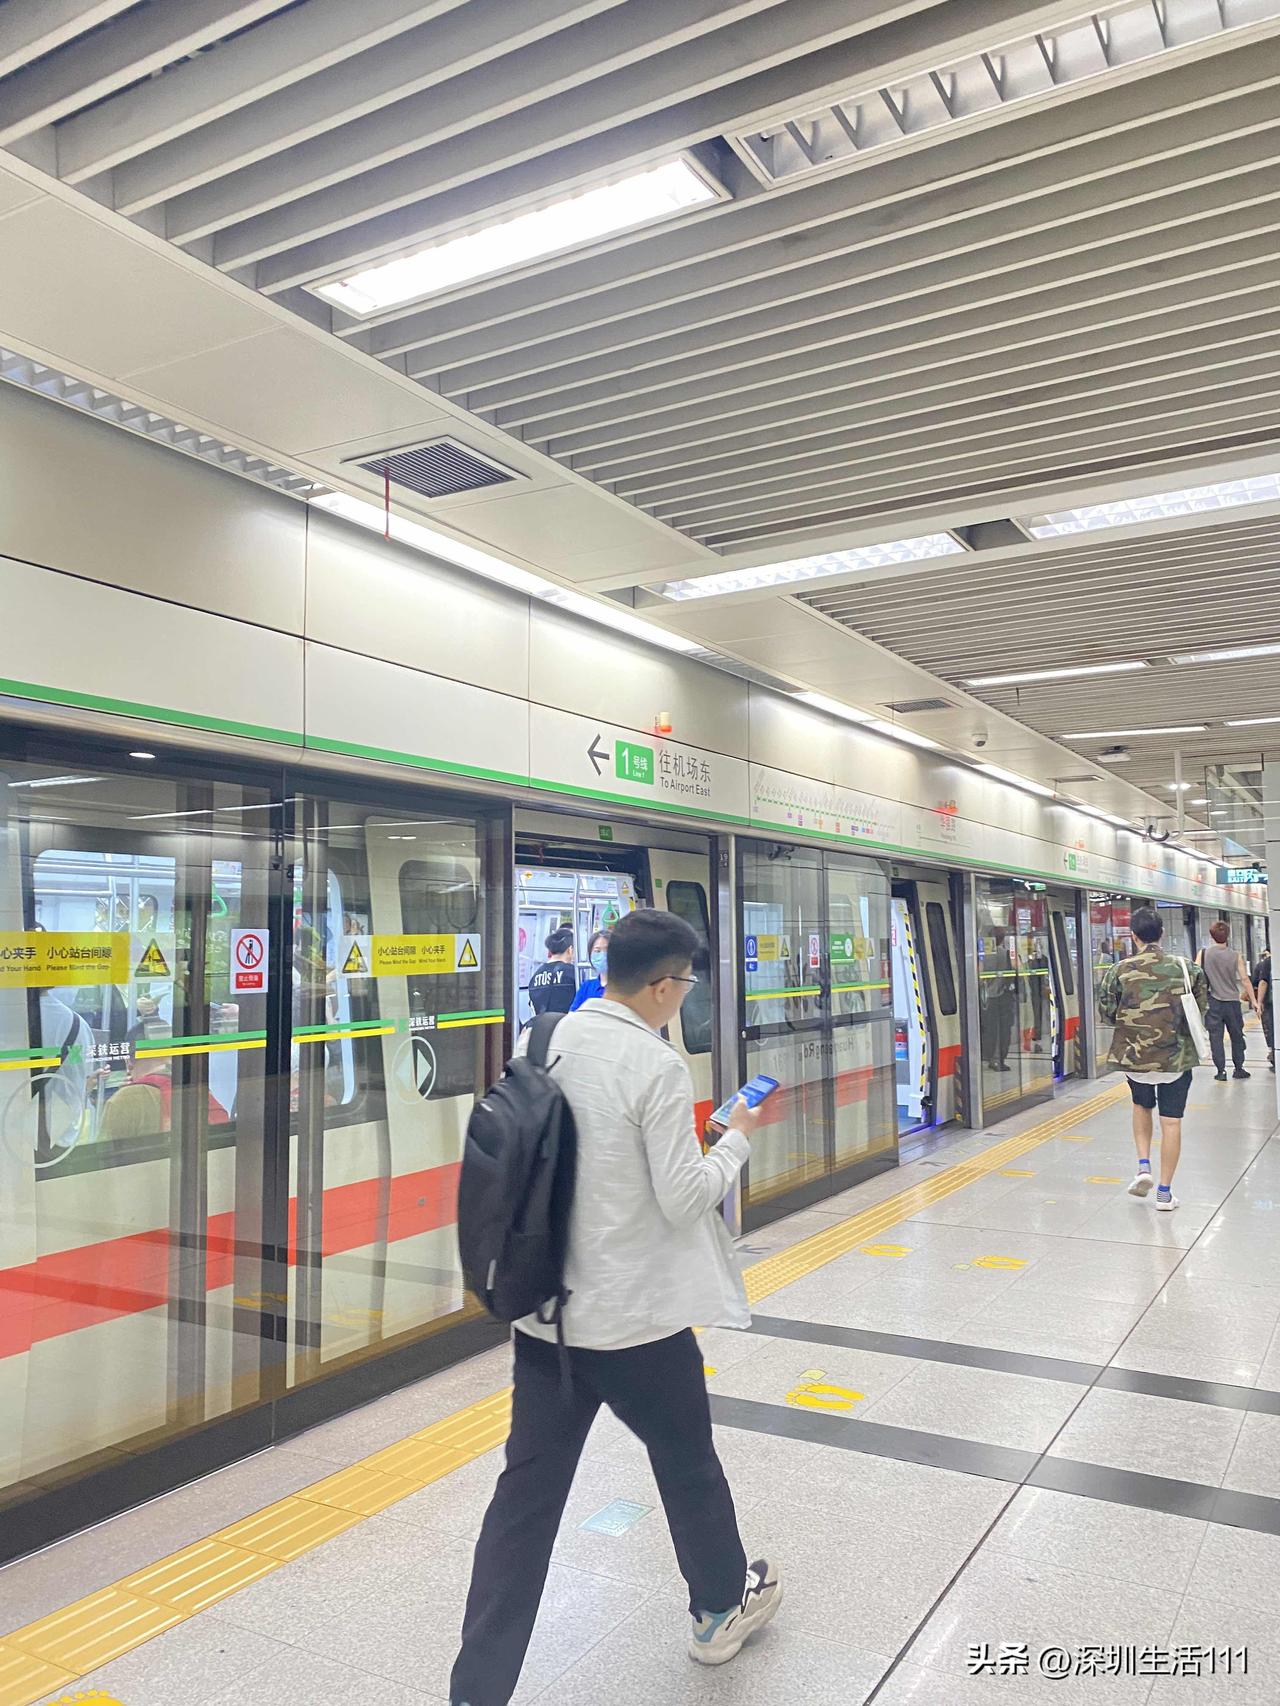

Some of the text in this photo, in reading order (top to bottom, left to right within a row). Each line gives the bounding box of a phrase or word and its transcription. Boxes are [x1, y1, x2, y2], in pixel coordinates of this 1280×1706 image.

[621, 747, 630, 775] 1
[633, 755, 648, 771] 号线
[659, 749, 711, 783] 往机场东
[660, 777, 711, 797] To Airport East
[47, 946, 112, 960] 小心站台间隙
